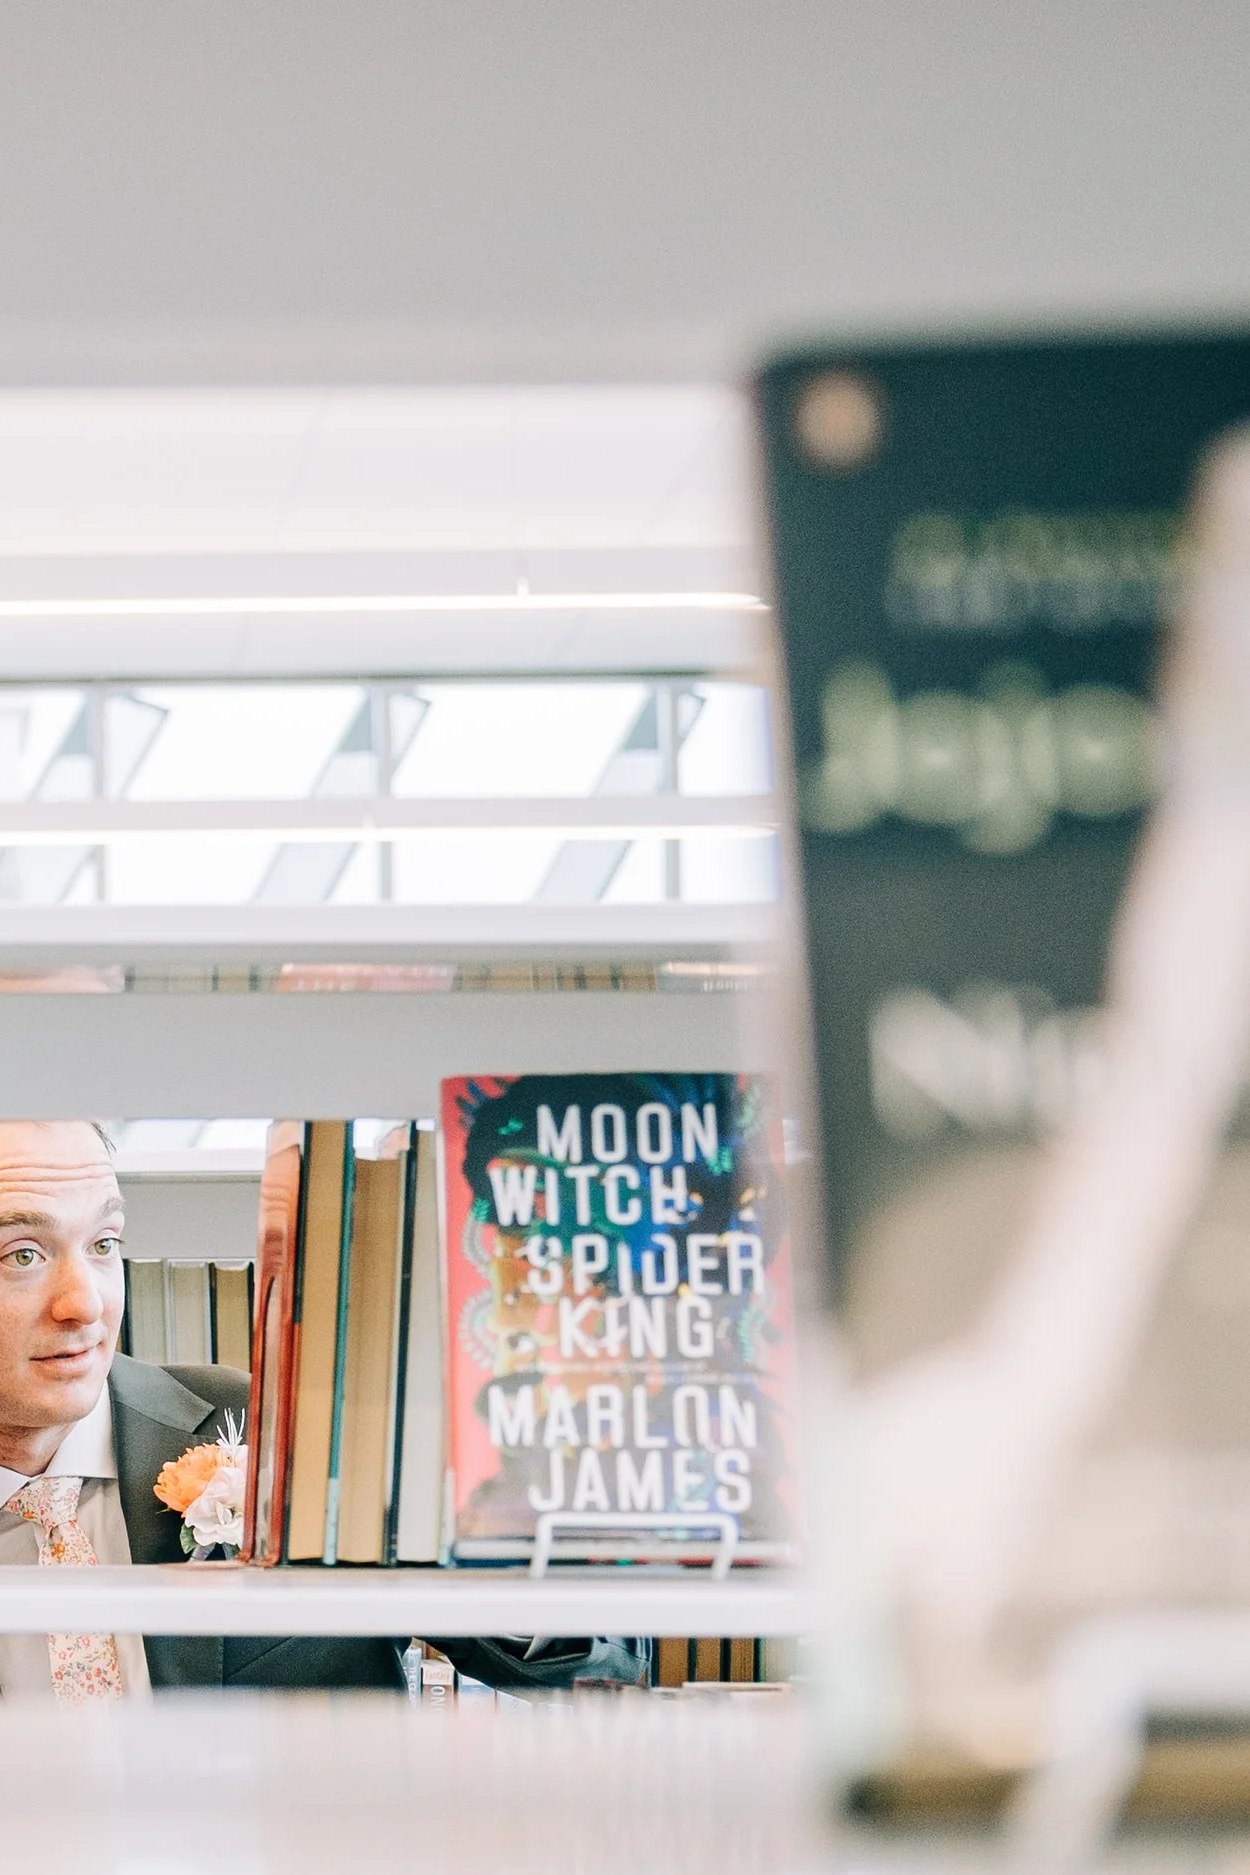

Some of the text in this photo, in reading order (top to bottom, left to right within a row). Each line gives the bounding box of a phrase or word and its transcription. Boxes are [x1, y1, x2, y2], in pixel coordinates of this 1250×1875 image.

[535, 1102, 719, 1165] MOON
[489, 1165, 690, 1227] WITCH
[526, 1233, 766, 1296] SPIDER
[558, 1297, 716, 1360] KING
[487, 1384, 758, 1449] MARLON
[528, 1450, 754, 1515] JAMES
